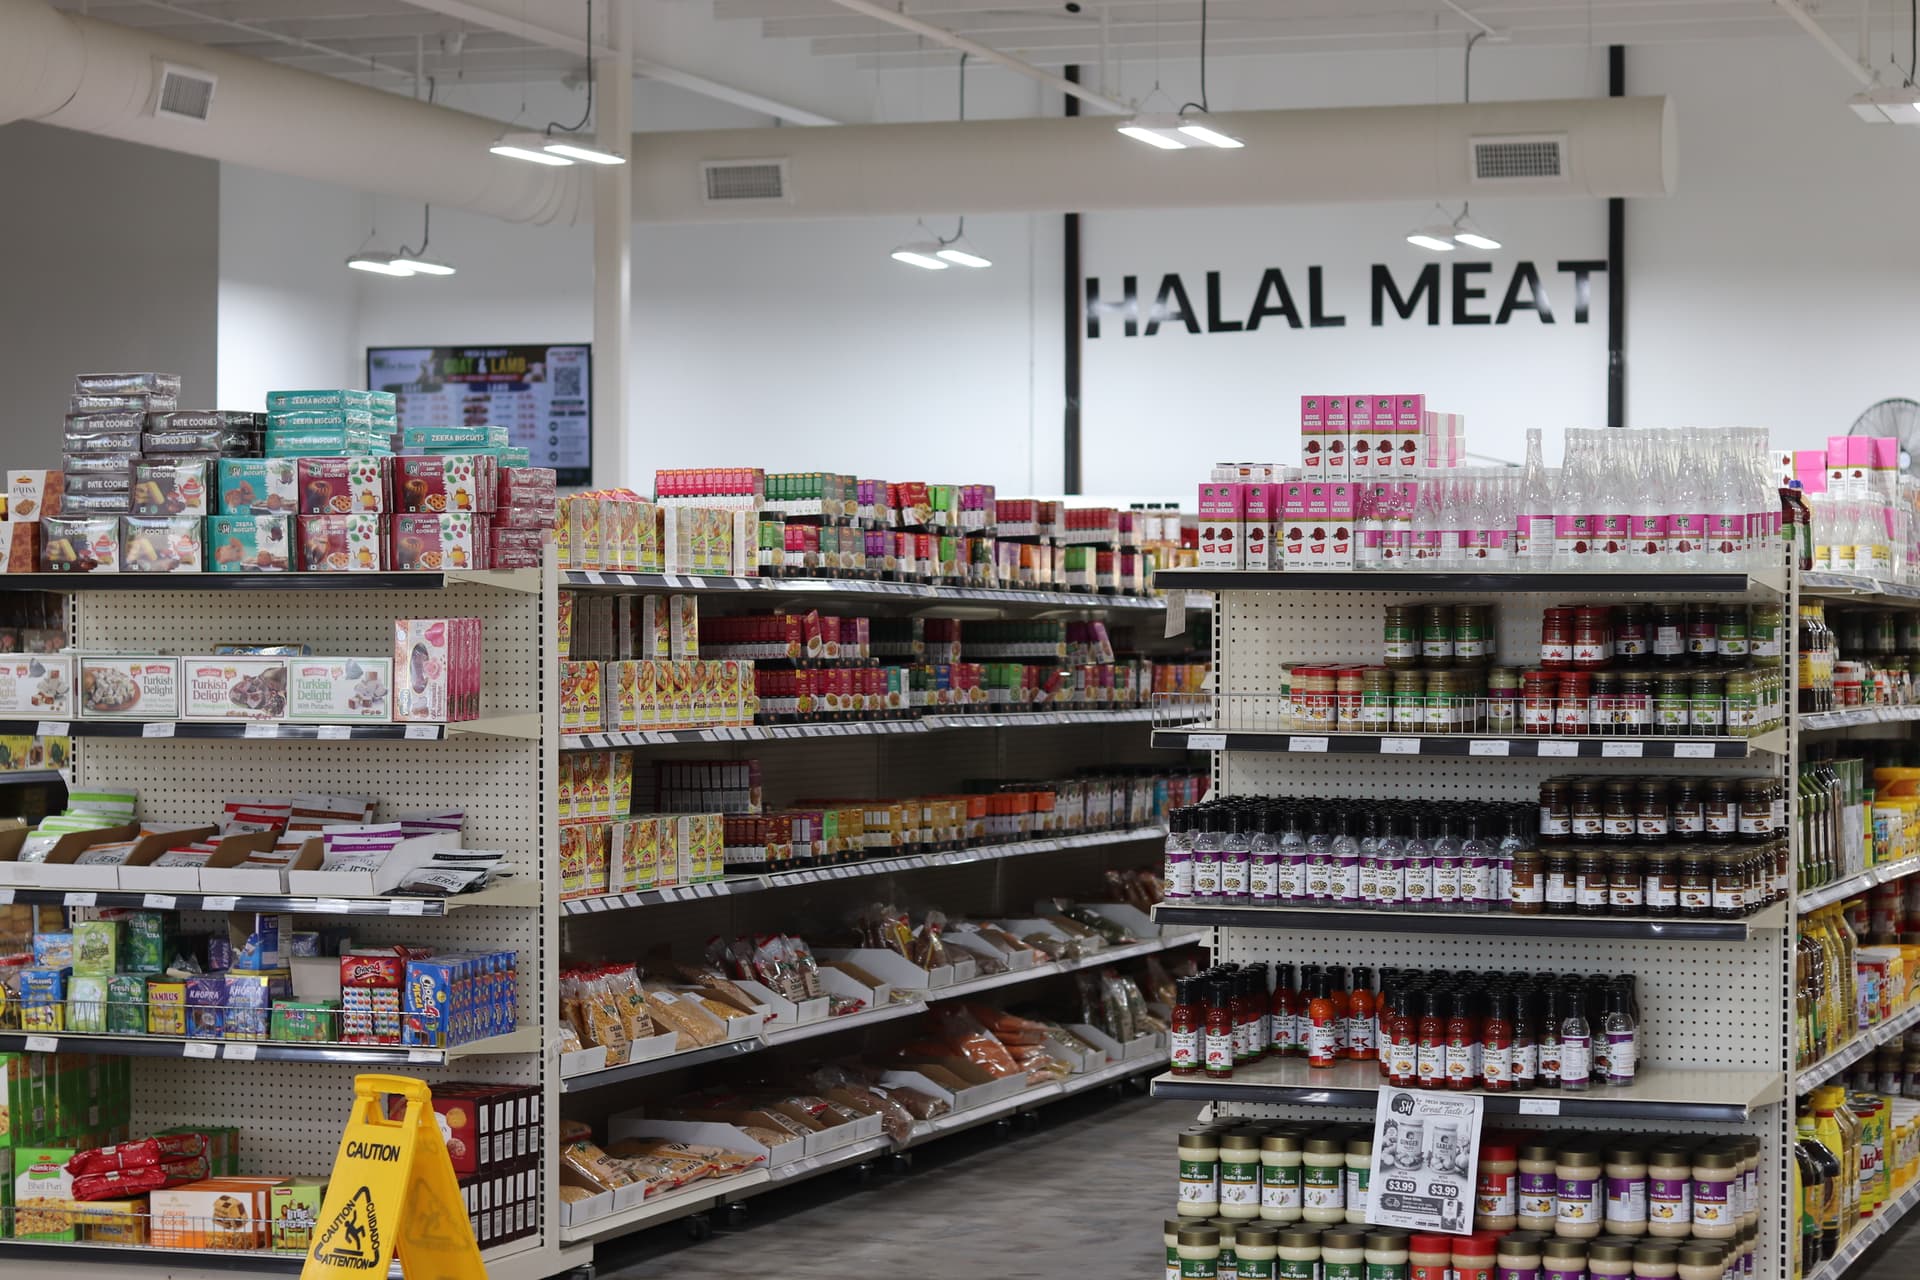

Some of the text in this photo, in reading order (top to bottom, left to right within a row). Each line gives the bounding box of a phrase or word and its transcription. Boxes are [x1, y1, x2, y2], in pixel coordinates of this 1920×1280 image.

[1085, 260, 1608, 339] HALAL MEAT
[490, 357, 527, 373] LAMB
[88, 420, 134, 428] DATE COOKIES
[172, 418, 218, 427] DATE COOKIES
[431, 434, 454, 442] ZEERA
[143, 676, 173, 685] Turkish
[191, 679, 228, 689] Turkish
[296, 679, 332, 689] Turkish
[143, 685, 173, 697] Delight
[192, 690, 228, 702] Delight
[296, 690, 332, 701] Delight
[427, 874, 466, 888] JERKY
[110, 984, 130, 992] Fresh
[189, 989, 219, 1000] KHOPRA
[412, 982, 424, 1009] MEGA
[1399, 1100, 1414, 1116] SH
[346, 1141, 401, 1162] CAUTION
[1388, 1180, 1414, 1192] $3.99
[1431, 1185, 1457, 1197] $3.99
[321, 1199, 356, 1244] CAUTION
[366, 1201, 381, 1251] CUIDADO
[320, 1254, 370, 1270] ATTENTION
